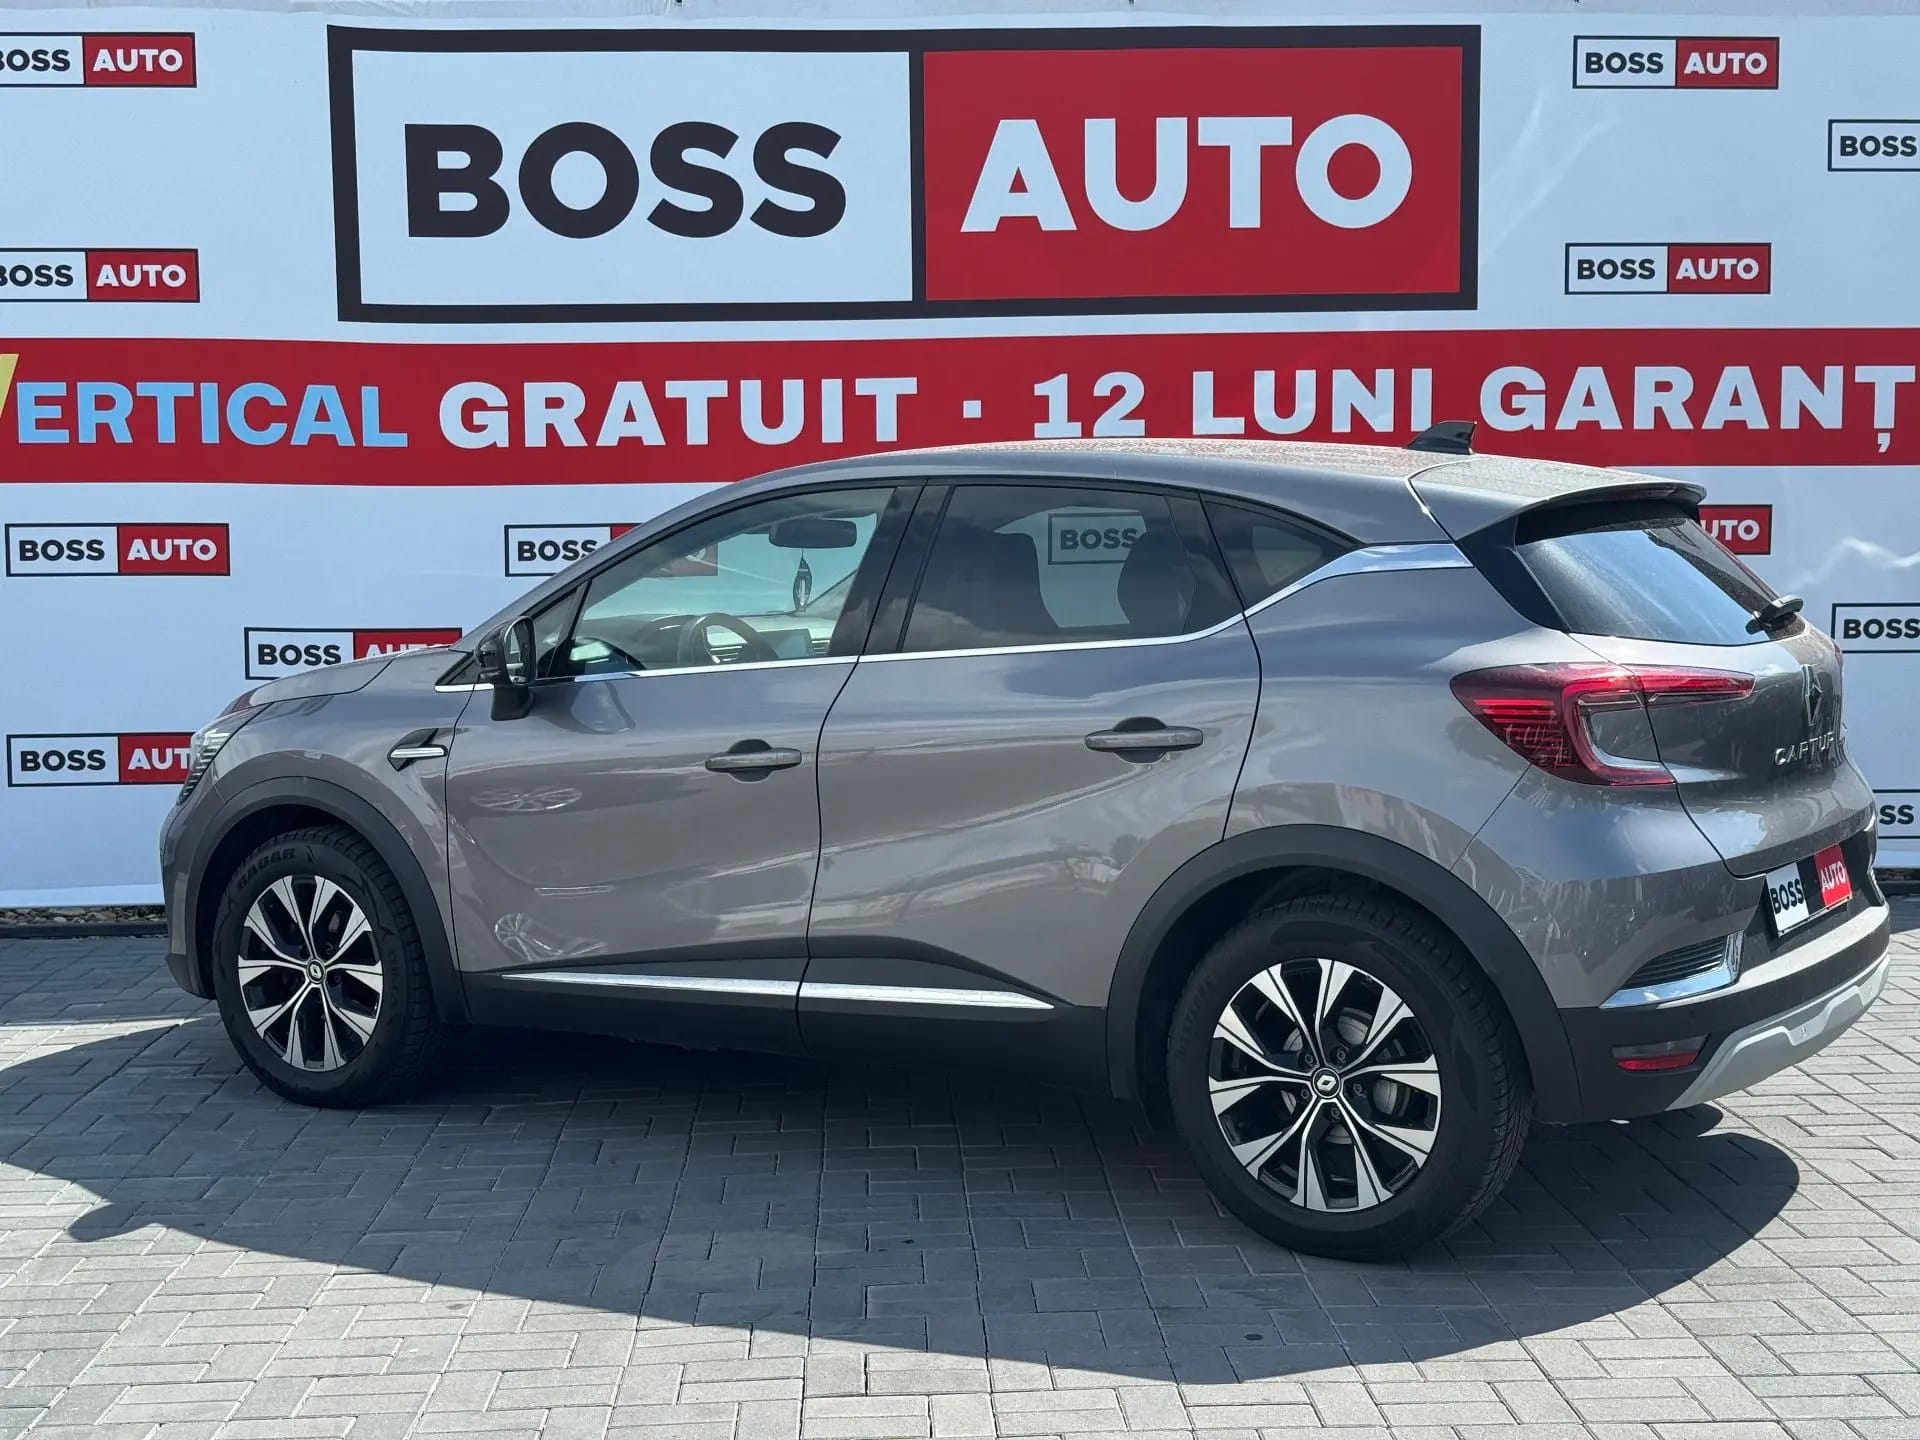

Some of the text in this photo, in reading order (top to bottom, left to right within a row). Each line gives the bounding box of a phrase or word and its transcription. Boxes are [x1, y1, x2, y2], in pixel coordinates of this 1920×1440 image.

[0, 49, 183, 71] OSS AUTO
[1586, 52, 1768, 75] BOSS AUTO
[1839, 136, 1917, 157] BOSS
[405, 114, 1412, 238] BOSS AUTO
[96, 265, 187, 288] AUTO
[1577, 258, 1759, 280] BOSS AUTO
[438, 376, 918, 449] GRATUIT
[1033, 371, 1146, 438] 12
[1192, 368, 1433, 437] LUNI
[1479, 365, 1916, 454] GARANȚ
[1061, 528, 1138, 550] BOSS
[1700, 519, 1760, 541] UTO
[19, 539, 217, 562] BOSS AUTO
[1843, 619, 1920, 640] BOSS
[258, 644, 342, 666] BOSS
[20, 748, 192, 772] BOSS AUT
[1879, 804, 1915, 826] SS
[1769, 862, 1846, 915] BOSS AUTO
